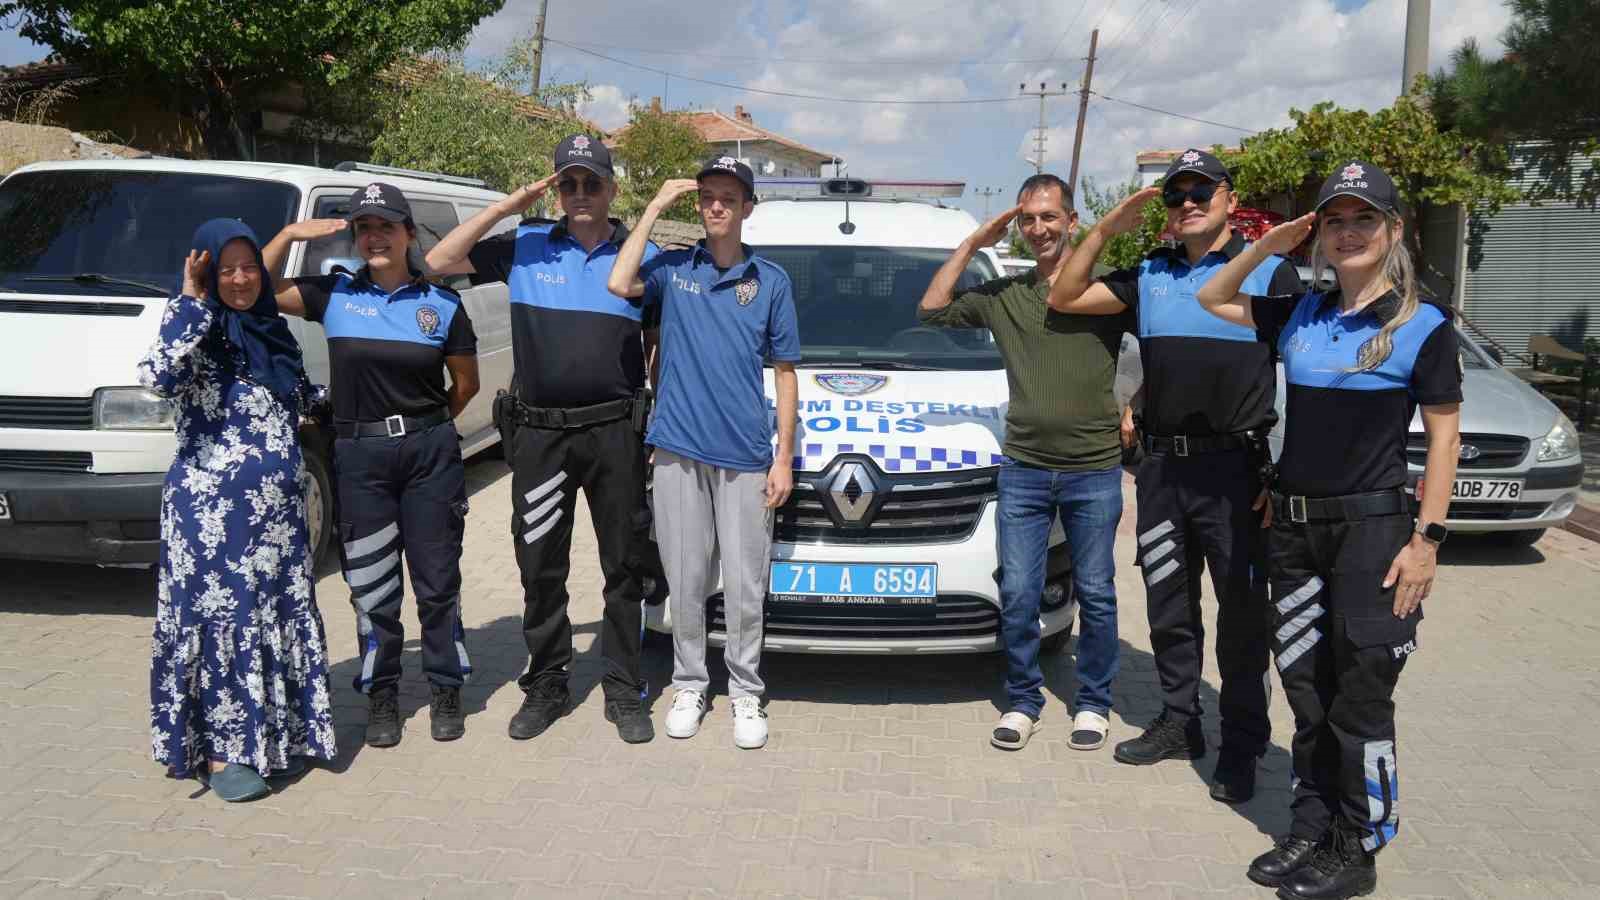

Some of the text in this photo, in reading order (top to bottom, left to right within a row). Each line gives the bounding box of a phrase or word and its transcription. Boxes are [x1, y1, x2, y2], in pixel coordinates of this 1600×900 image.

[797, 415, 926, 433] OLİS
[1487, 482, 1520, 498] 778
[789, 565, 931, 594] 71 A 6594
